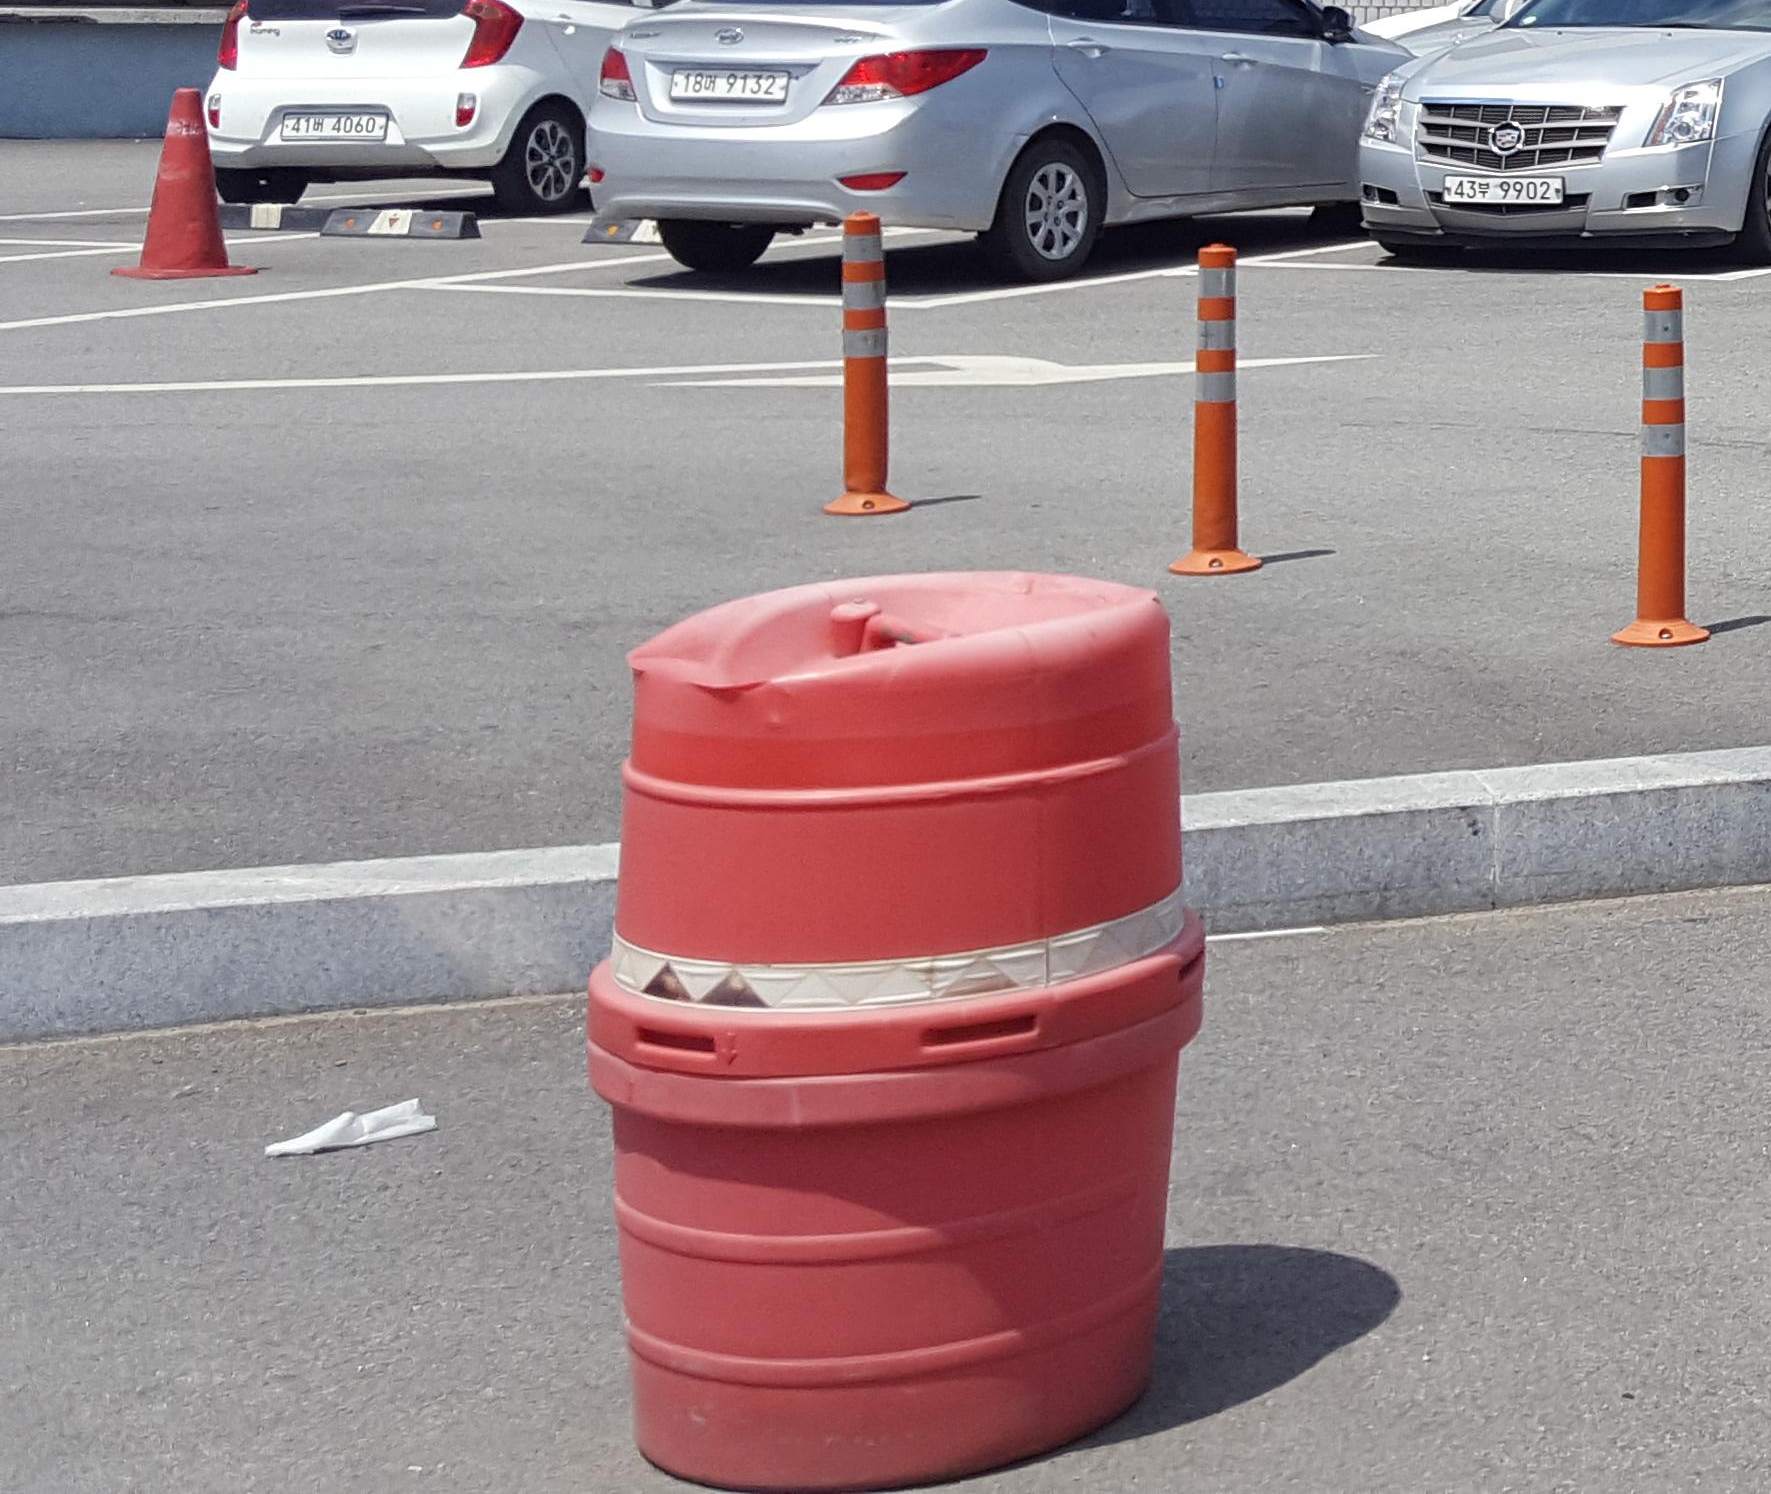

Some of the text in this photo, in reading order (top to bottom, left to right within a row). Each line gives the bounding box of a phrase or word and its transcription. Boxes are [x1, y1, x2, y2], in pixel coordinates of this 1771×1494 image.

[727, 73, 776, 96] 9132
[332, 116, 376, 134] 4060
[1454, 180, 1551, 200] 43부 9902
